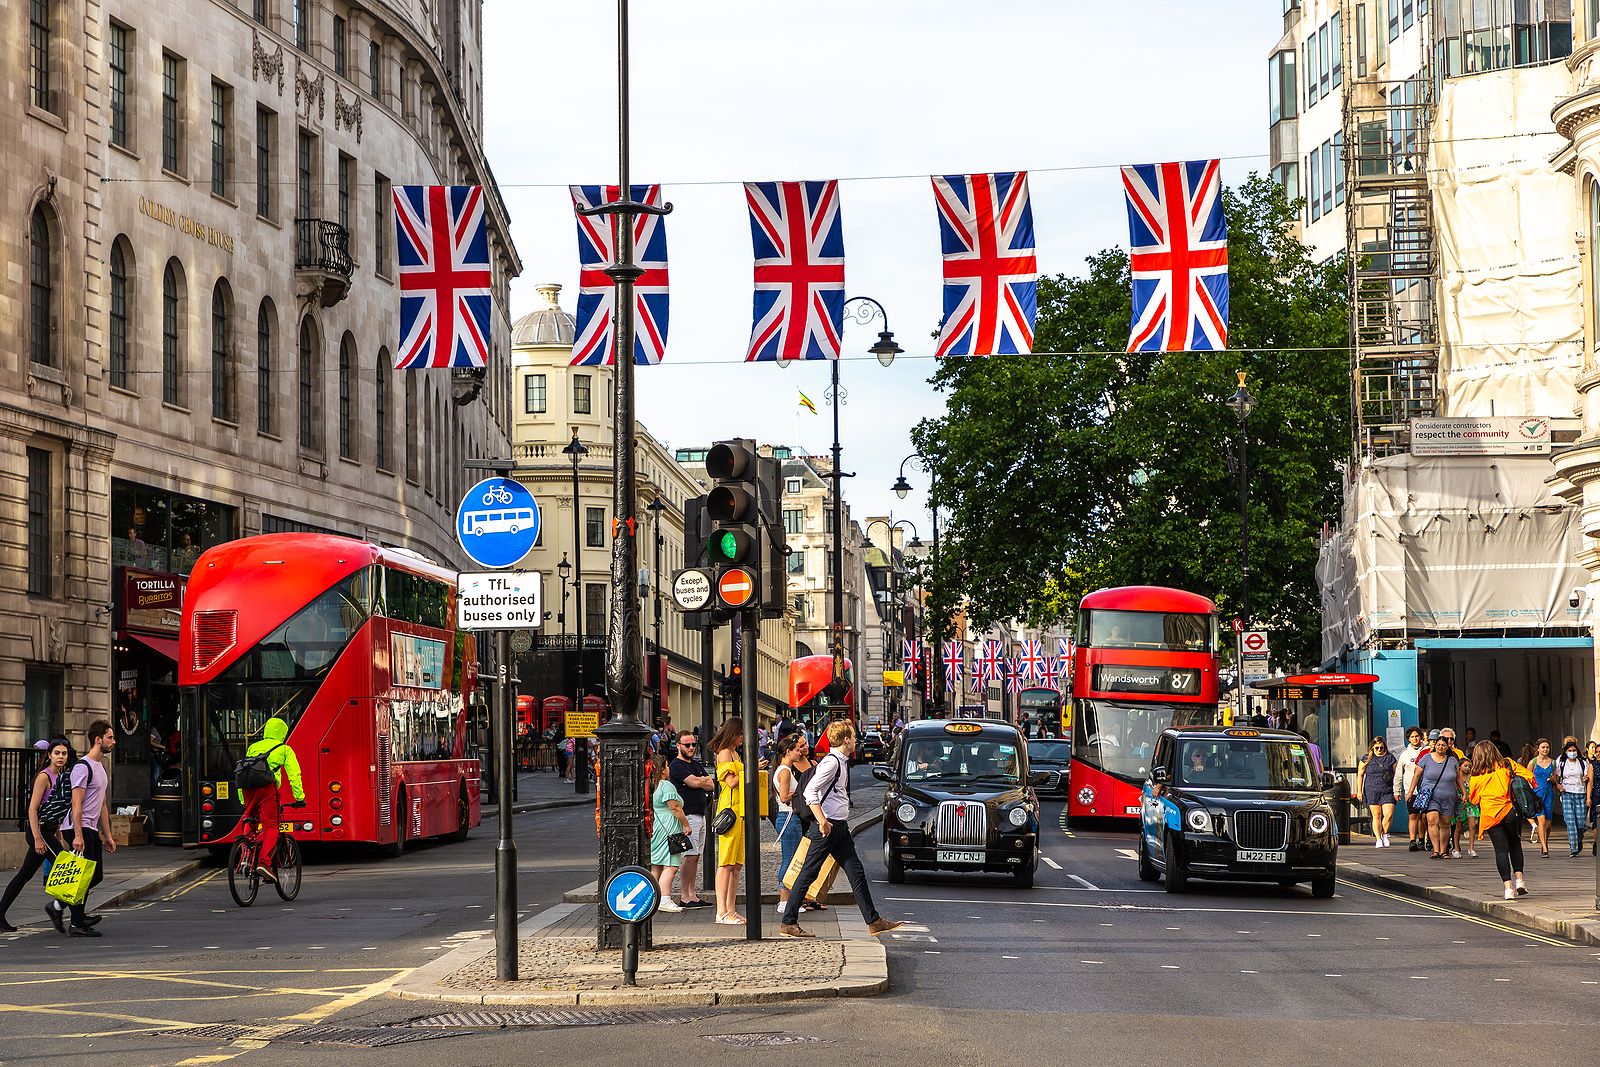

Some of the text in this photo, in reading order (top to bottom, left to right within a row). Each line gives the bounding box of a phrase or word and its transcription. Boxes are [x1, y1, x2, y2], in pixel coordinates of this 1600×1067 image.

[138, 195, 234, 254] GOLDEN CROSS HOUSE
[1415, 422, 1452, 430] Considerate
[1415, 430, 1510, 440] respect the community
[136, 580, 175, 590] TORTILLA
[488, 578, 511, 590] TfL
[680, 577, 703, 585] Except
[463, 593, 535, 606] authorised
[682, 595, 703, 603] cycles
[463, 608, 535, 622] buses only
[1235, 620, 1242, 631] K
[500, 664, 507, 674] S
[501, 674, 506, 684] 1
[1100, 673, 1192, 689] Wandsworth 87
[942, 851, 980, 861] KF17 CNJ
[1265, 852, 1283, 862] FEJ
[54, 860, 77, 870] FAST.
[50, 867, 82, 879] FRESH.
[48, 876, 79, 887] LOCAL.
